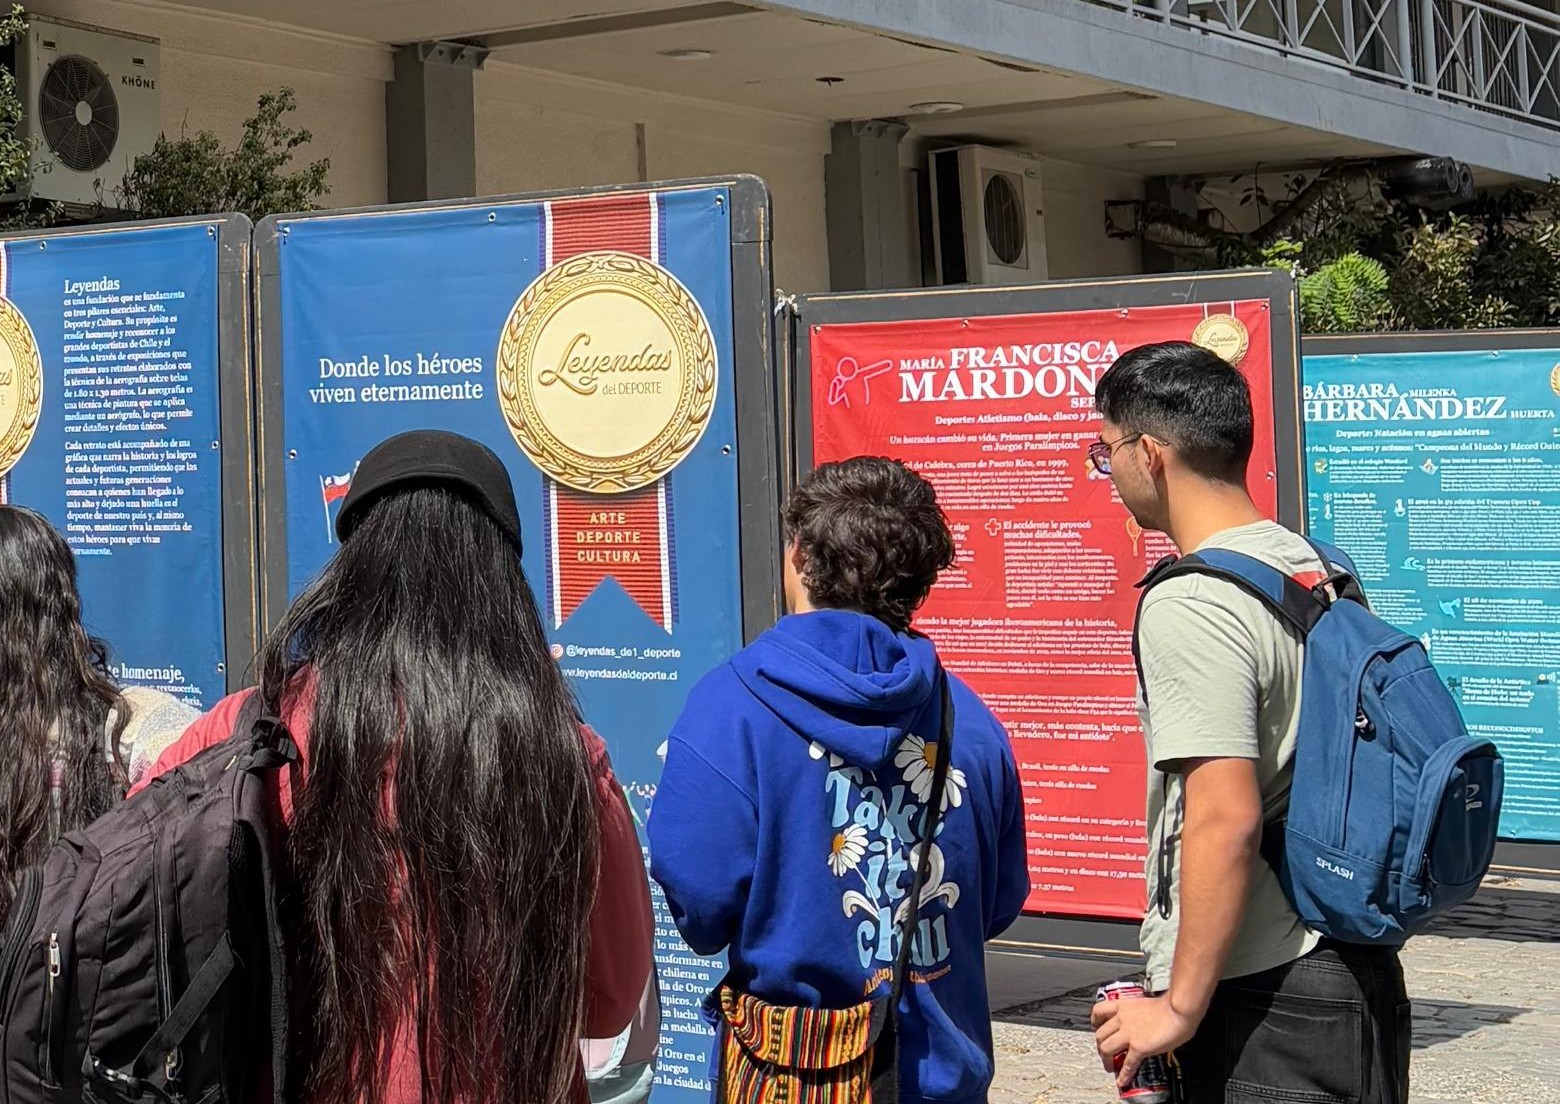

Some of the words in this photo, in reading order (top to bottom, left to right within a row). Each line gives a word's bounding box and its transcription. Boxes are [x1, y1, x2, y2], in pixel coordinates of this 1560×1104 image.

[64, 277, 120, 296] Leyendas
[129, 339, 138, 348] de
[139, 338, 157, 348] Chile
[172, 351, 187, 360] que
[900, 356, 945, 370] MARÍA
[950, 340, 1121, 369] FRANCISCA
[320, 356, 380, 379] Donde
[385, 355, 413, 375] los
[417, 352, 482, 375] héroes
[538, 332, 672, 396] Leyendas
[309, 385, 355, 404] viven
[361, 381, 483, 401] eternamente
[602, 381, 617, 396] del
[619, 381, 662, 396] DEPORTE
[1303, 382, 1399, 399] BÁRBARA
[1304, 393, 1507, 421] HERNÁNDEZ
[1511, 410, 1555, 418] HUERTA
[935, 416, 975, 426] Deporte:
[977, 414, 1022, 423] Atletismo
[1024, 412, 1051, 422] (bala,
[1053, 412, 1078, 421] disco
[994, 439, 1023, 452] Juegos
[1024, 438, 1080, 451] Paralímpicos.
[589, 512, 626, 525] ARTE
[1003, 521, 1012, 529] El
[1013, 520, 1049, 529] accidente
[576, 531, 641, 543] DEPORTE
[577, 549, 641, 563] CULTURA
[122, 663, 185, 683] homenaje,
[866, 840, 908, 900] it
[1316, 857, 1354, 880] SPLASH
[669, 942, 688, 951] más
[712, 959, 723, 968] en
[663, 968, 697, 980] chilena
[672, 984, 684, 992] de
[687, 985, 704, 993] Oro
[674, 1009, 698, 1020] lucha
[671, 1024, 707, 1035] medalla
[665, 1050, 682, 1060] Oro
[684, 1053, 695, 1061] en
